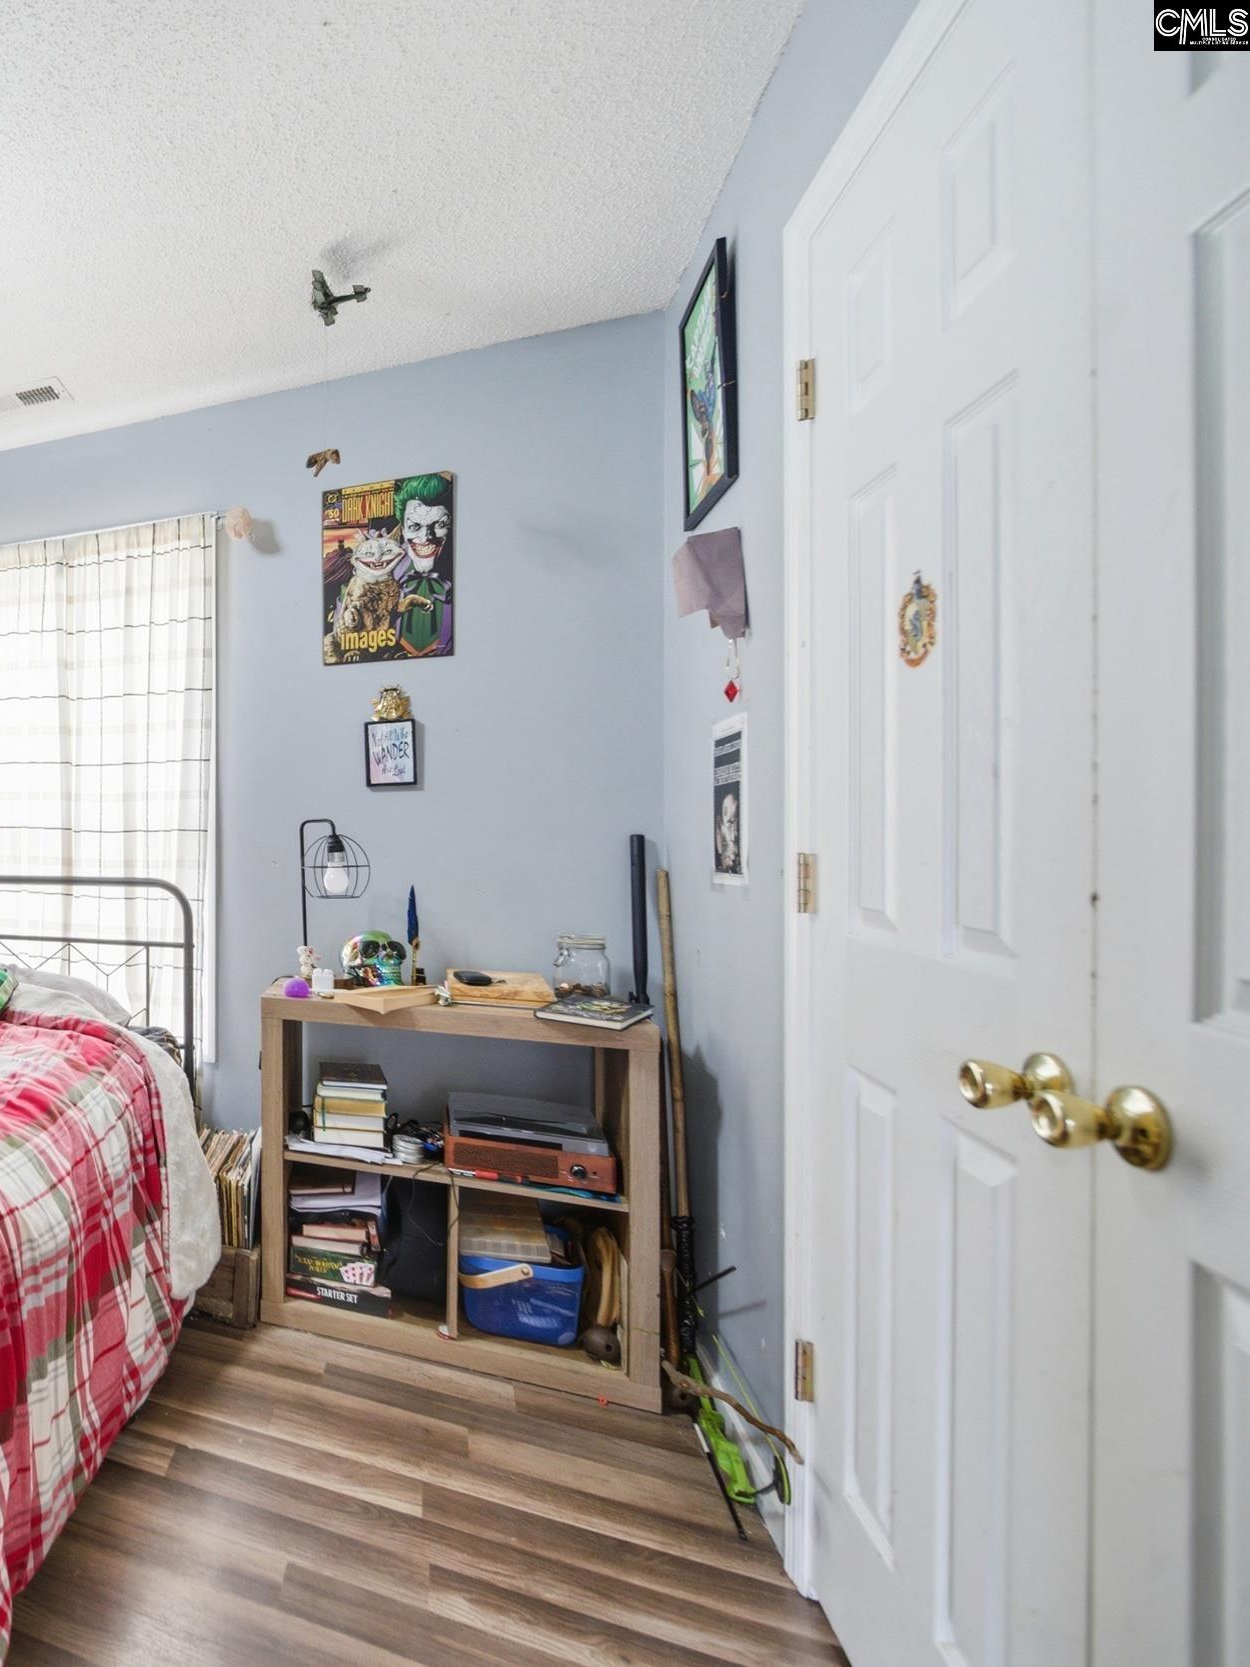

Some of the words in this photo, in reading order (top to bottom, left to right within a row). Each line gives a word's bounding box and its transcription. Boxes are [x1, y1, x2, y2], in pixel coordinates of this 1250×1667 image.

[341, 494, 367, 524] DARK
[366, 490, 395, 523] KNIGHT
[372, 741, 410, 766] WANDER
[316, 1286, 346, 1301] STARTER
[346, 1292, 359, 1304] SET
